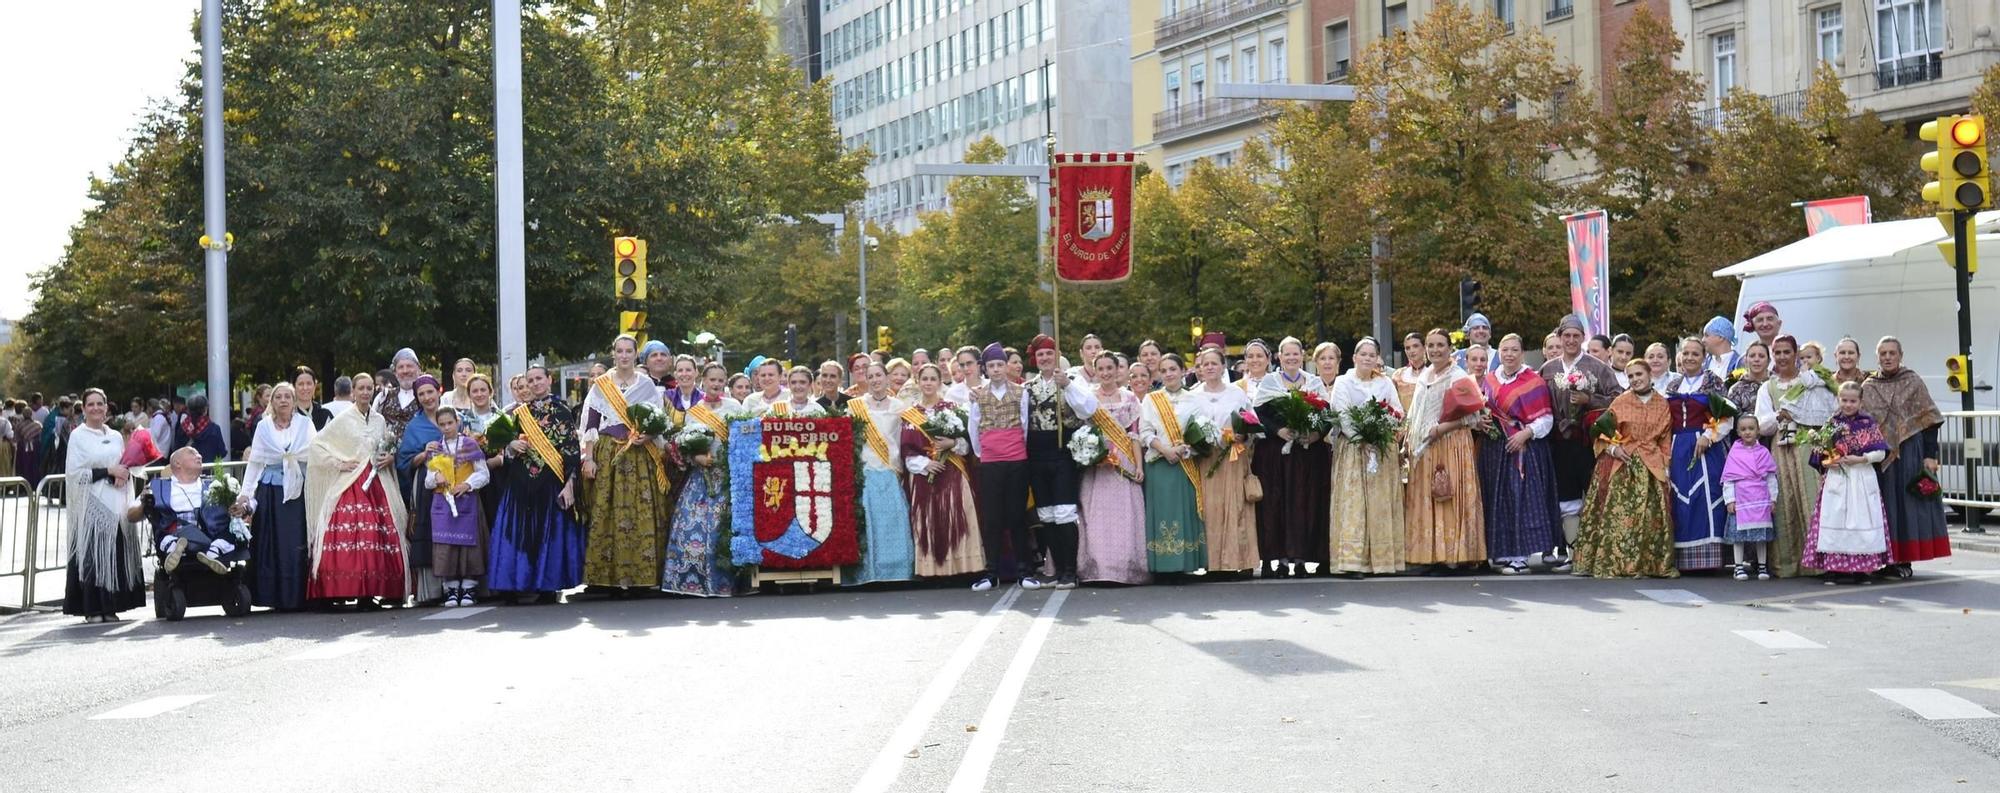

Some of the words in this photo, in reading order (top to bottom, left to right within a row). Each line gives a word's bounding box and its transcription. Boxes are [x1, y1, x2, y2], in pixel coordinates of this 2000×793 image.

[1063, 232, 1072, 246] EL
[1069, 242, 1096, 261] BURGO
[1097, 252, 1111, 261] DE
[763, 421, 816, 432] BURGO
[771, 435, 791, 446] DE
[800, 431, 839, 443] EBRO
